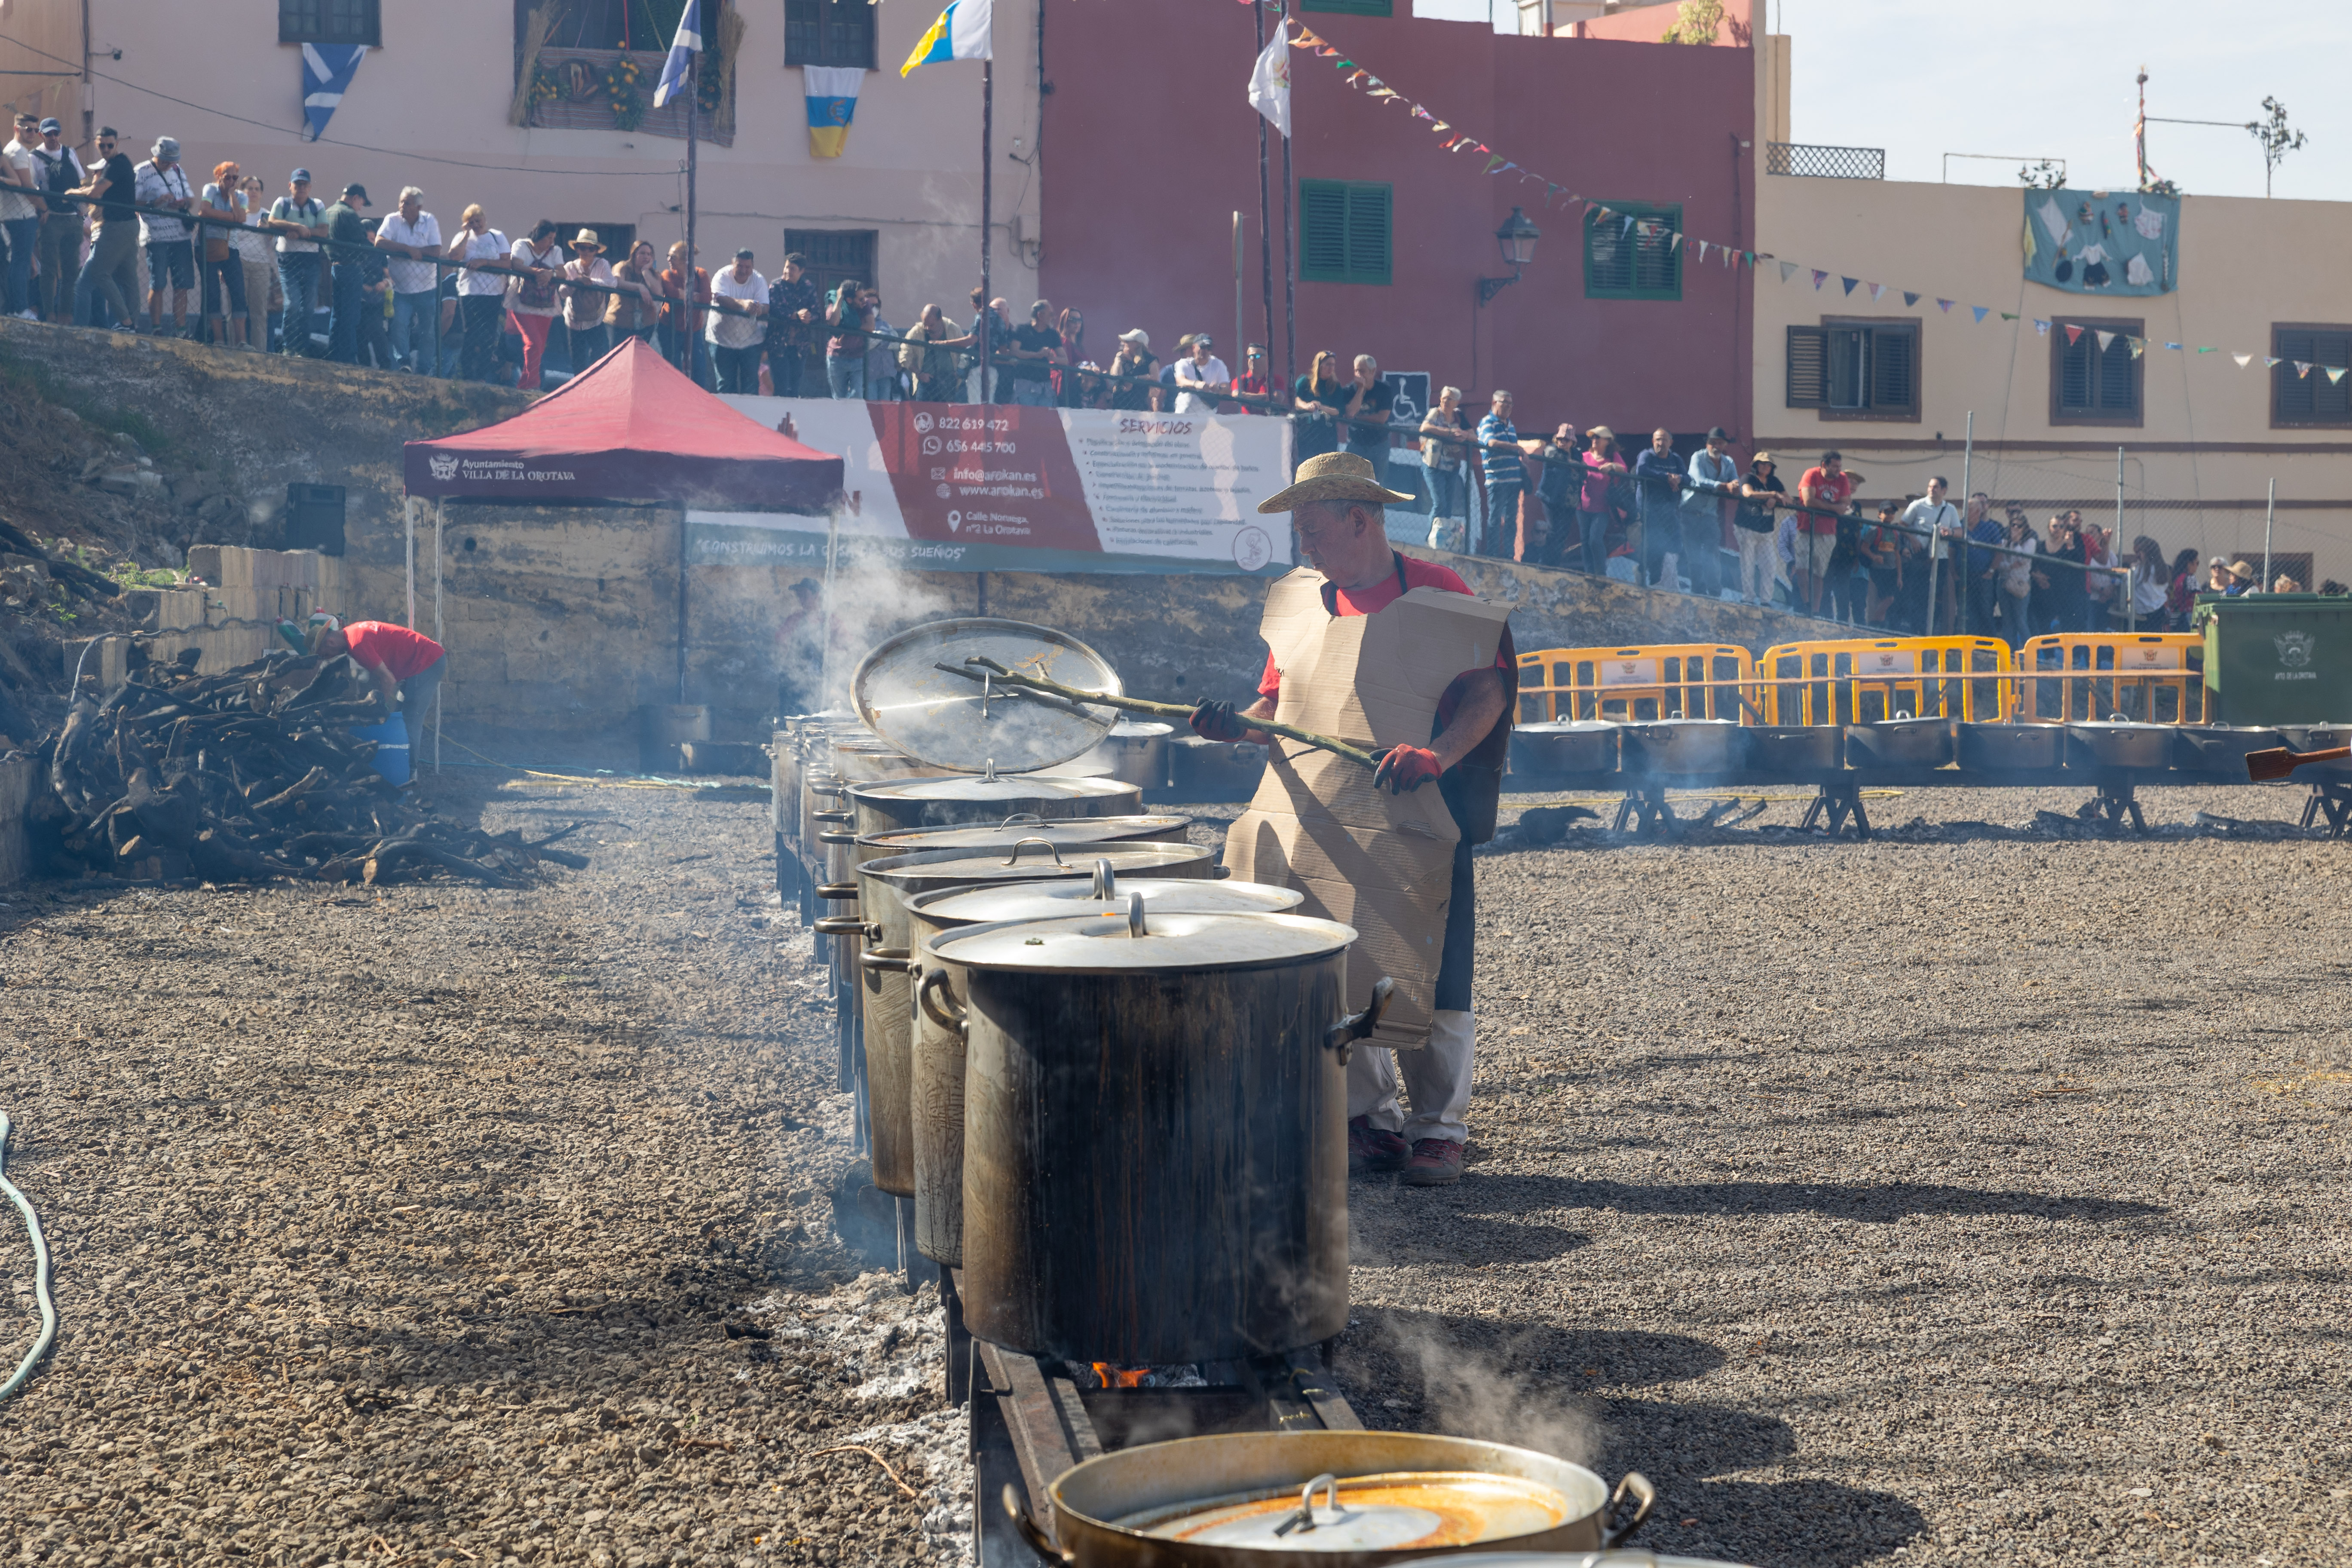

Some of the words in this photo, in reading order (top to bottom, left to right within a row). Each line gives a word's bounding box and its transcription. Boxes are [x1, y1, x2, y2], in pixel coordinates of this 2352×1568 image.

[939, 416, 960, 429] 822
[962, 417, 985, 430] 619
[987, 420, 1009, 431] 472
[1119, 418, 1192, 435] SERVICIOS
[946, 439, 968, 453] 656
[970, 441, 992, 453] 445
[995, 442, 1015, 454] 700
[462, 459, 524, 469] Ayuntamiento
[462, 470, 492, 480] VILLA
[495, 470, 510, 480] DE
[511, 470, 525, 481] LA
[527, 471, 576, 482] OROTAVA
[954, 467, 1037, 482] info@arokan.es
[959, 484, 1044, 499] www.arokan.es
[966, 511, 988, 521] Calle
[983, 524, 994, 534] La
[995, 524, 1031, 535] Orotava
[799, 543, 815, 556] LA
